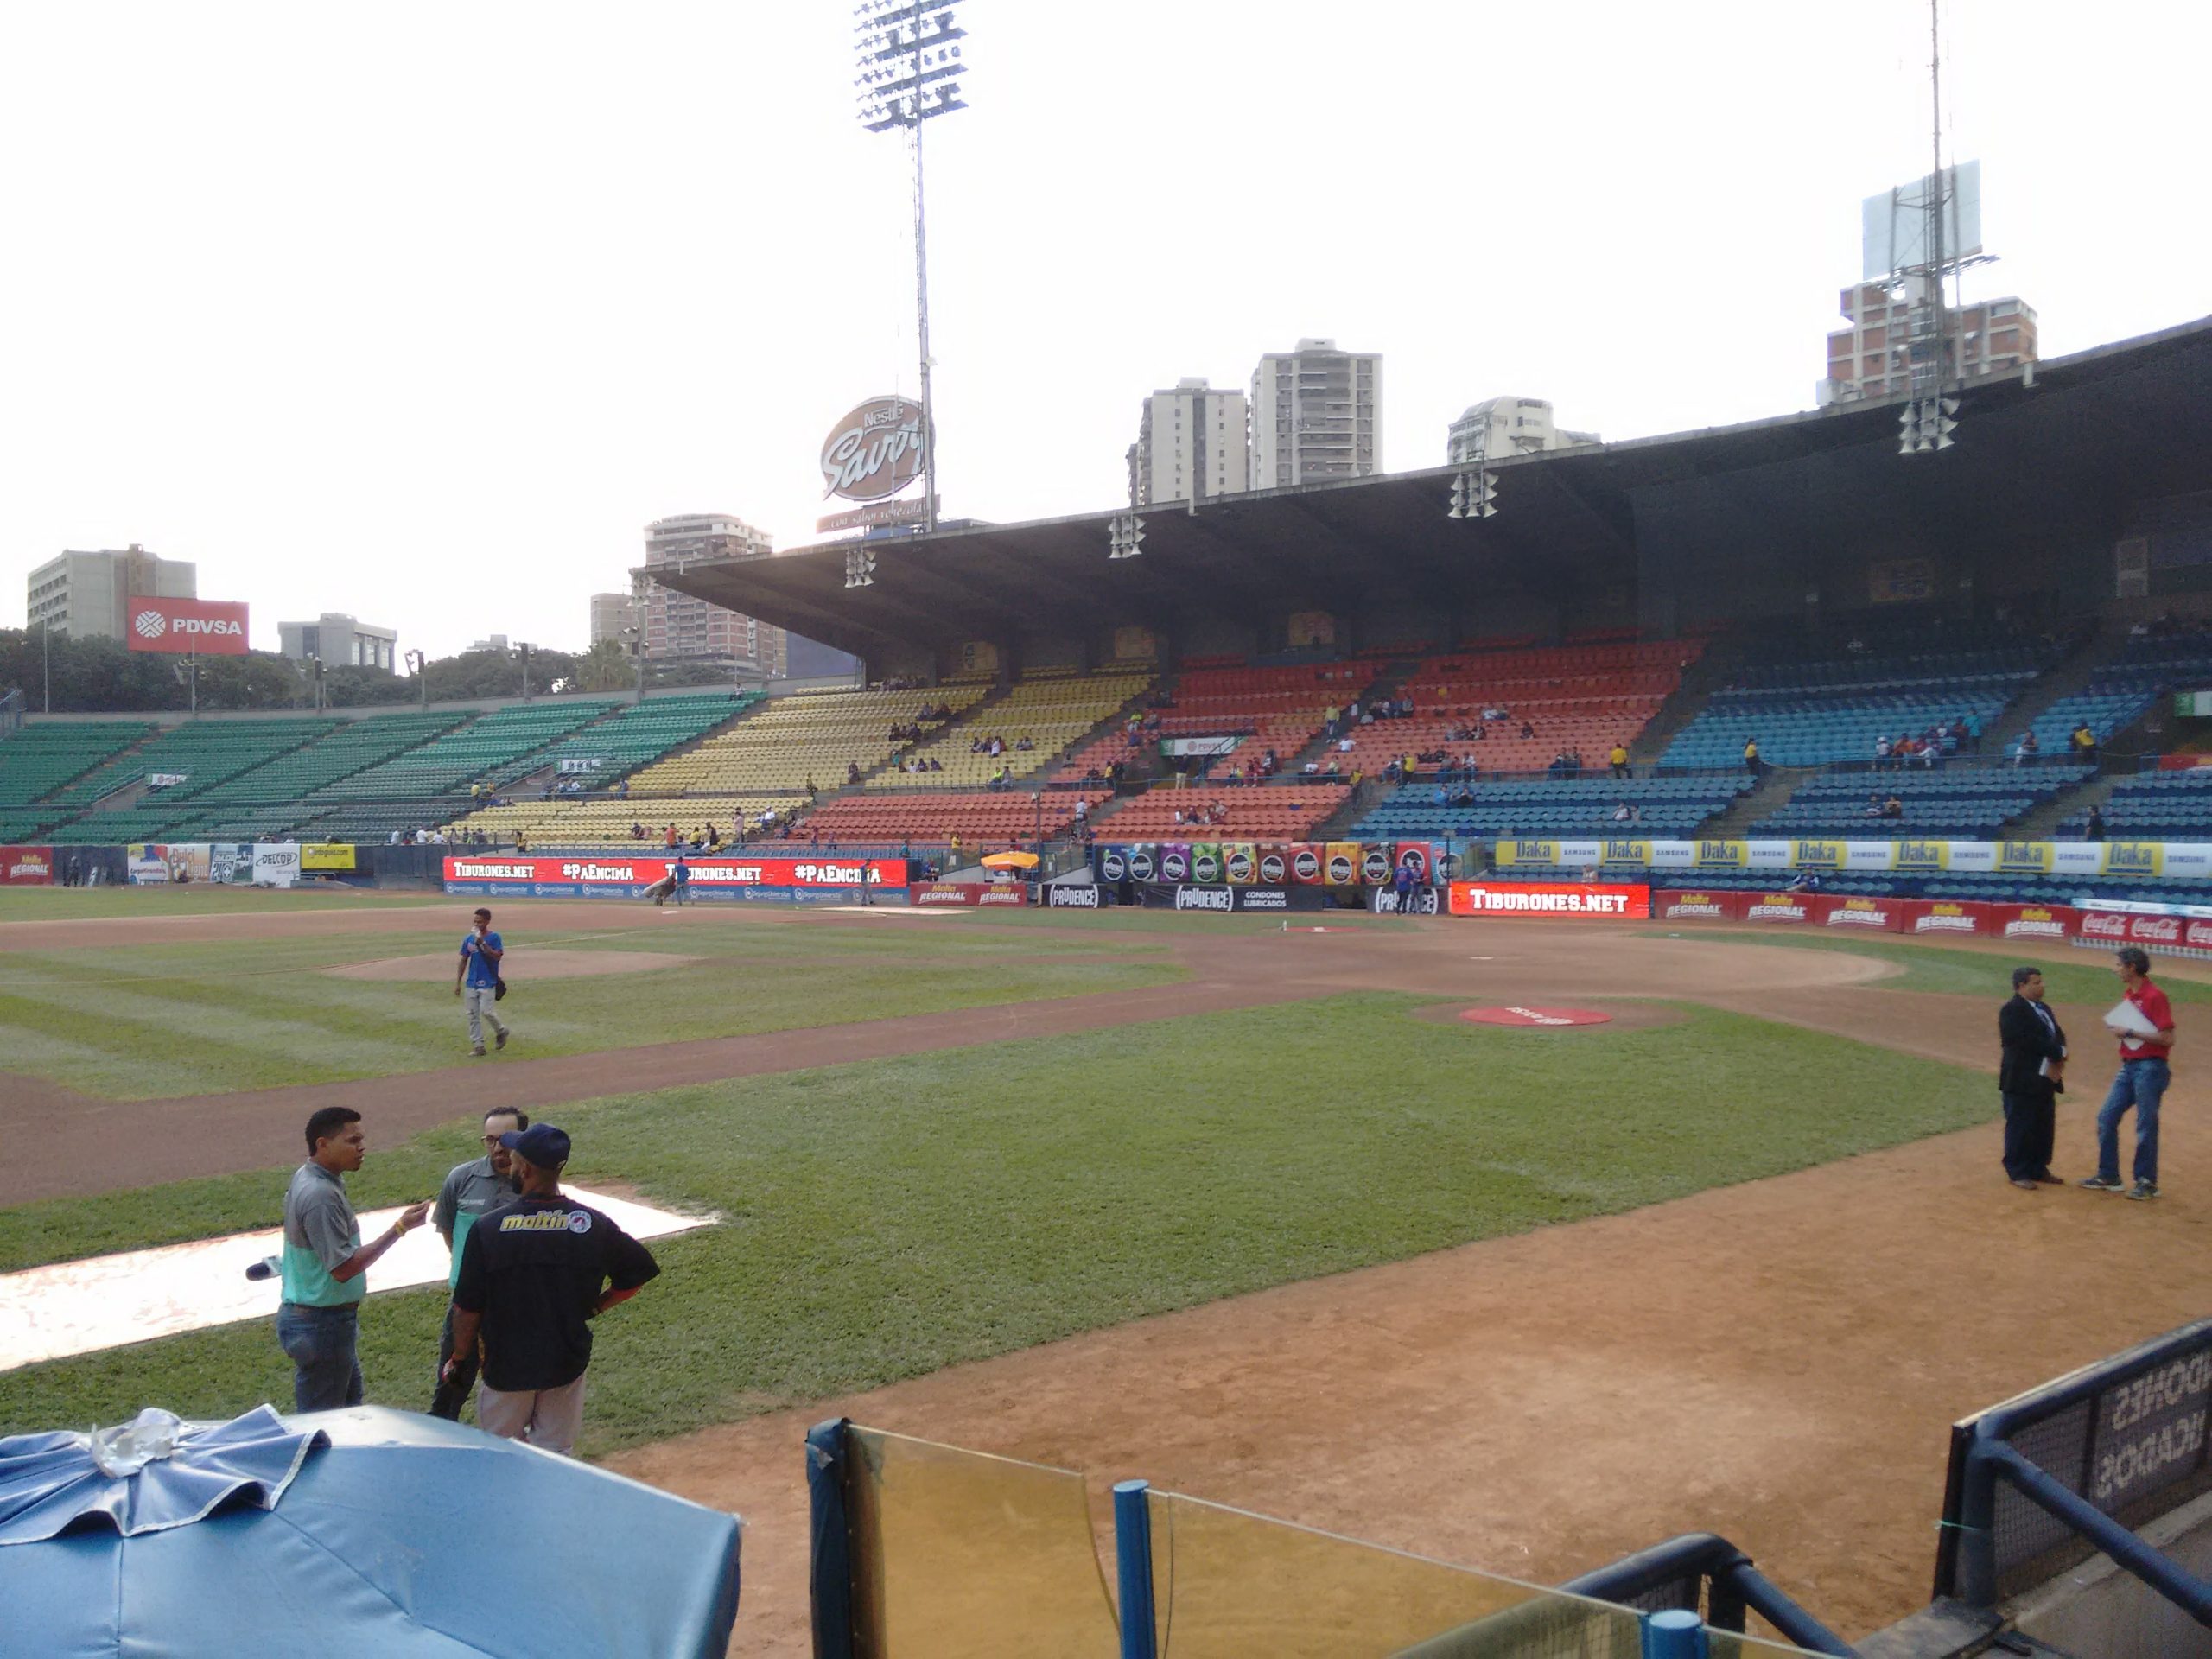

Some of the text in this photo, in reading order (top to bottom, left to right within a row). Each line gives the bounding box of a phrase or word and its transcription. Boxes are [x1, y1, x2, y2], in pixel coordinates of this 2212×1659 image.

[865, 404, 904, 426] Nestlé
[173, 618, 242, 635] PDVSA
[1516, 841, 1551, 858] Daka
[1607, 841, 1643, 858] Daka
[1701, 841, 1738, 860] Daka
[1798, 842, 1837, 861] Daka
[1899, 842, 1938, 861] Daka
[2004, 842, 2043, 862] Daka
[2109, 842, 2152, 865] Daka
[262, 854, 292, 865] DELCOP
[10, 865, 49, 877] REGIONAL
[919, 892, 966, 903] REGIONAL
[979, 893, 1020, 904] REGIONAL
[1681, 893, 1709, 905] Malta
[1668, 905, 1722, 917] REGIONAL
[1749, 906, 1806, 918] REGIONAL
[2082, 913, 2127, 935] Coca-Cola
[2131, 917, 2182, 939] Coca-Cola
[500, 1210, 569, 1231] maltín
